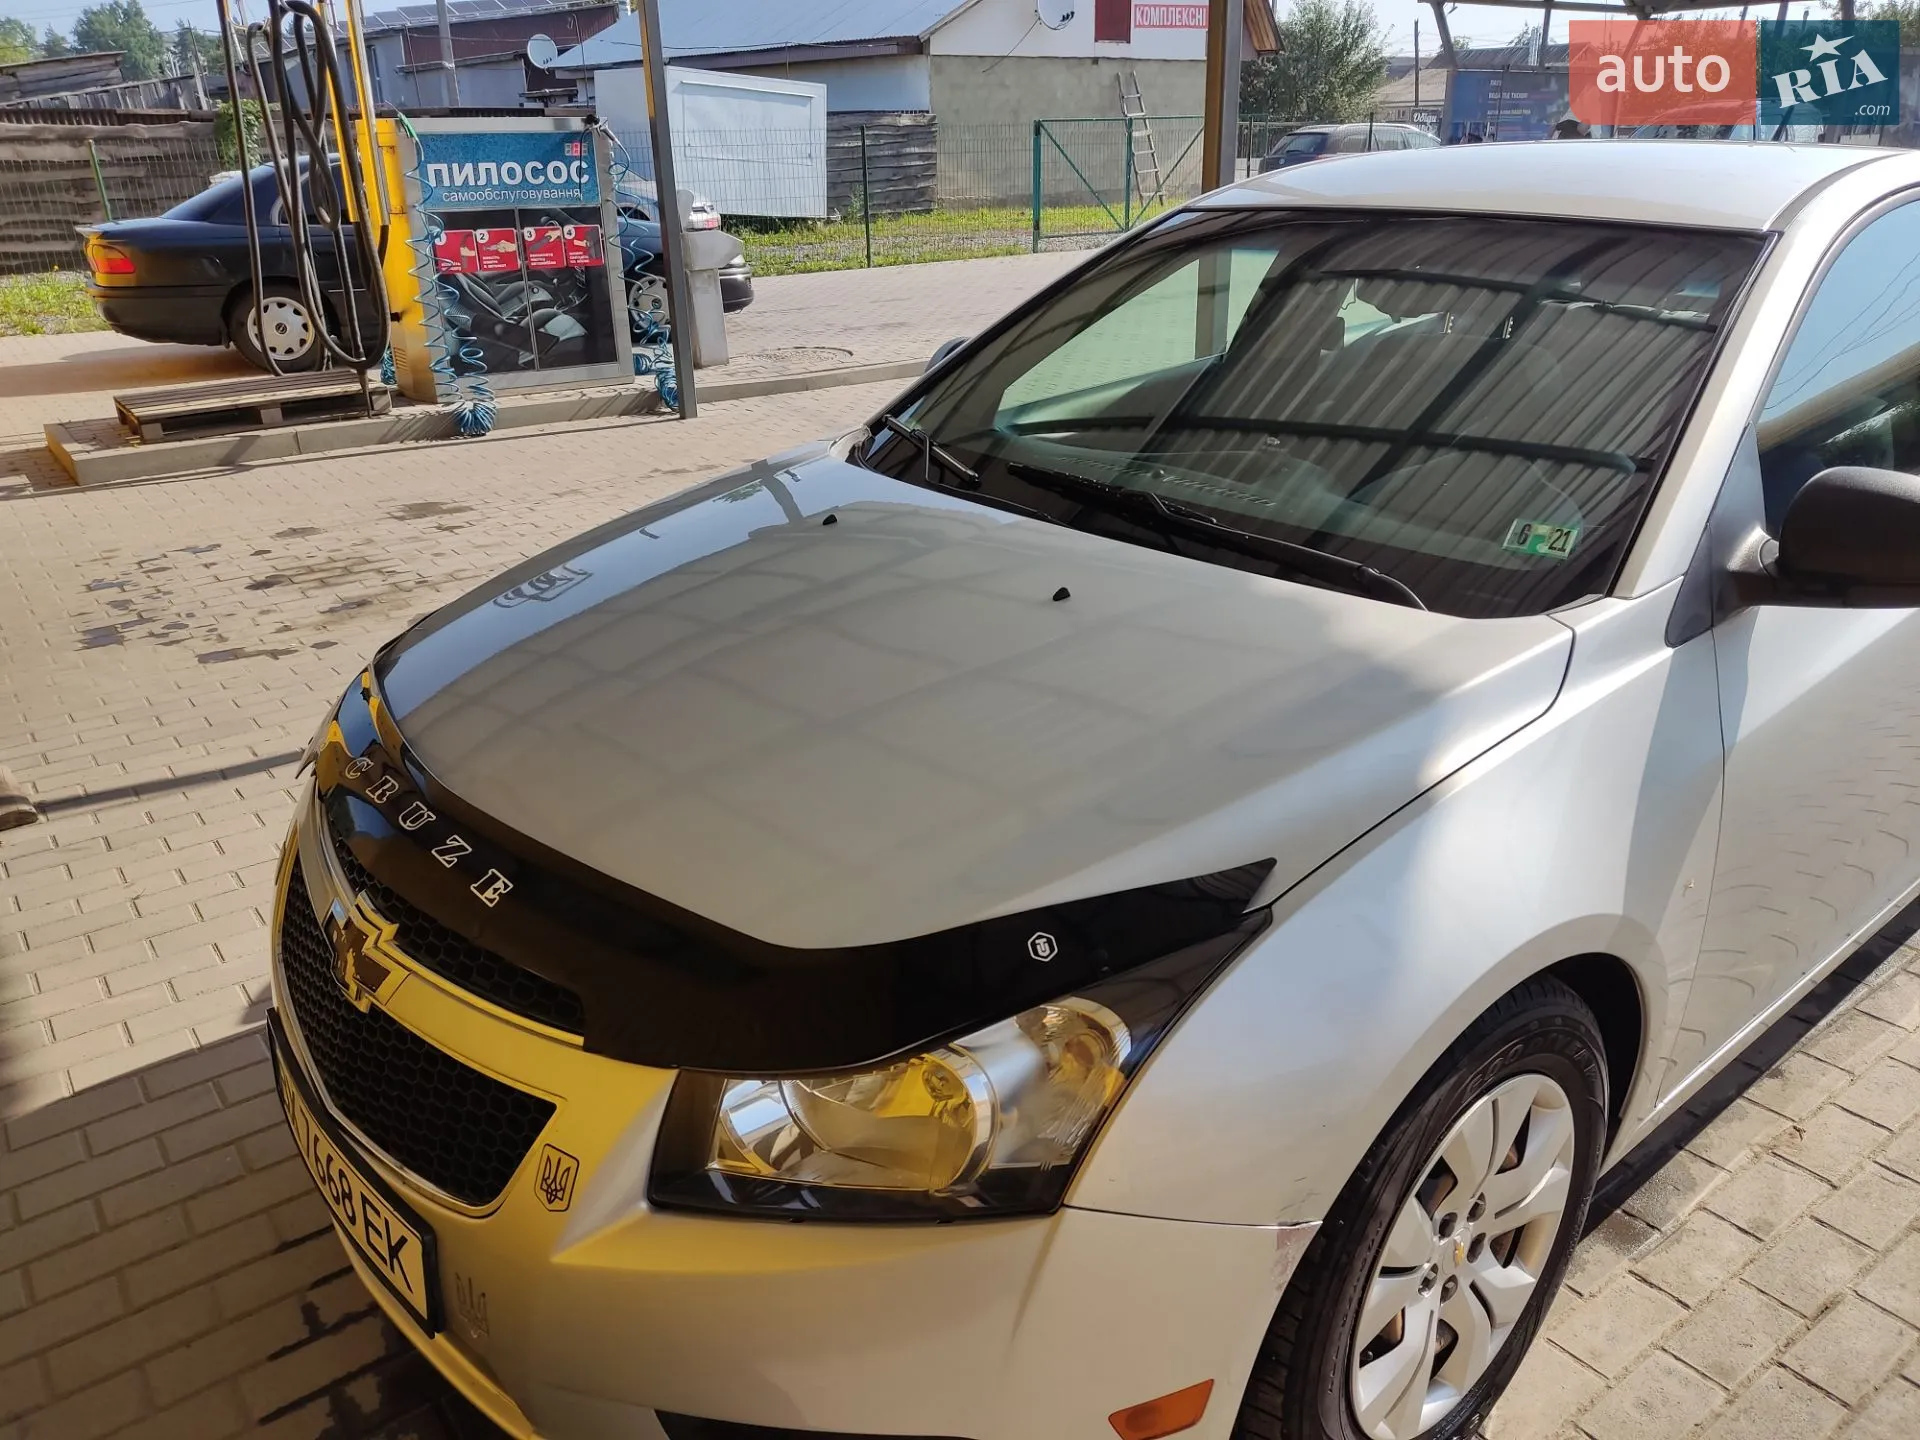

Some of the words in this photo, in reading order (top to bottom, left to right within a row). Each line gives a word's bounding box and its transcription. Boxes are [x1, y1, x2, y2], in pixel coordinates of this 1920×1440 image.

[1136, 6, 1207, 26] КОМПЛЕКСНІ
[442, 188, 582, 203] самообслуговування
[1517, 523, 1532, 545] 6
[1548, 528, 1572, 552] 21
[345, 757, 514, 908] CRUZE
[298, 1104, 357, 1227] 7668
[359, 1191, 415, 1296] EK
